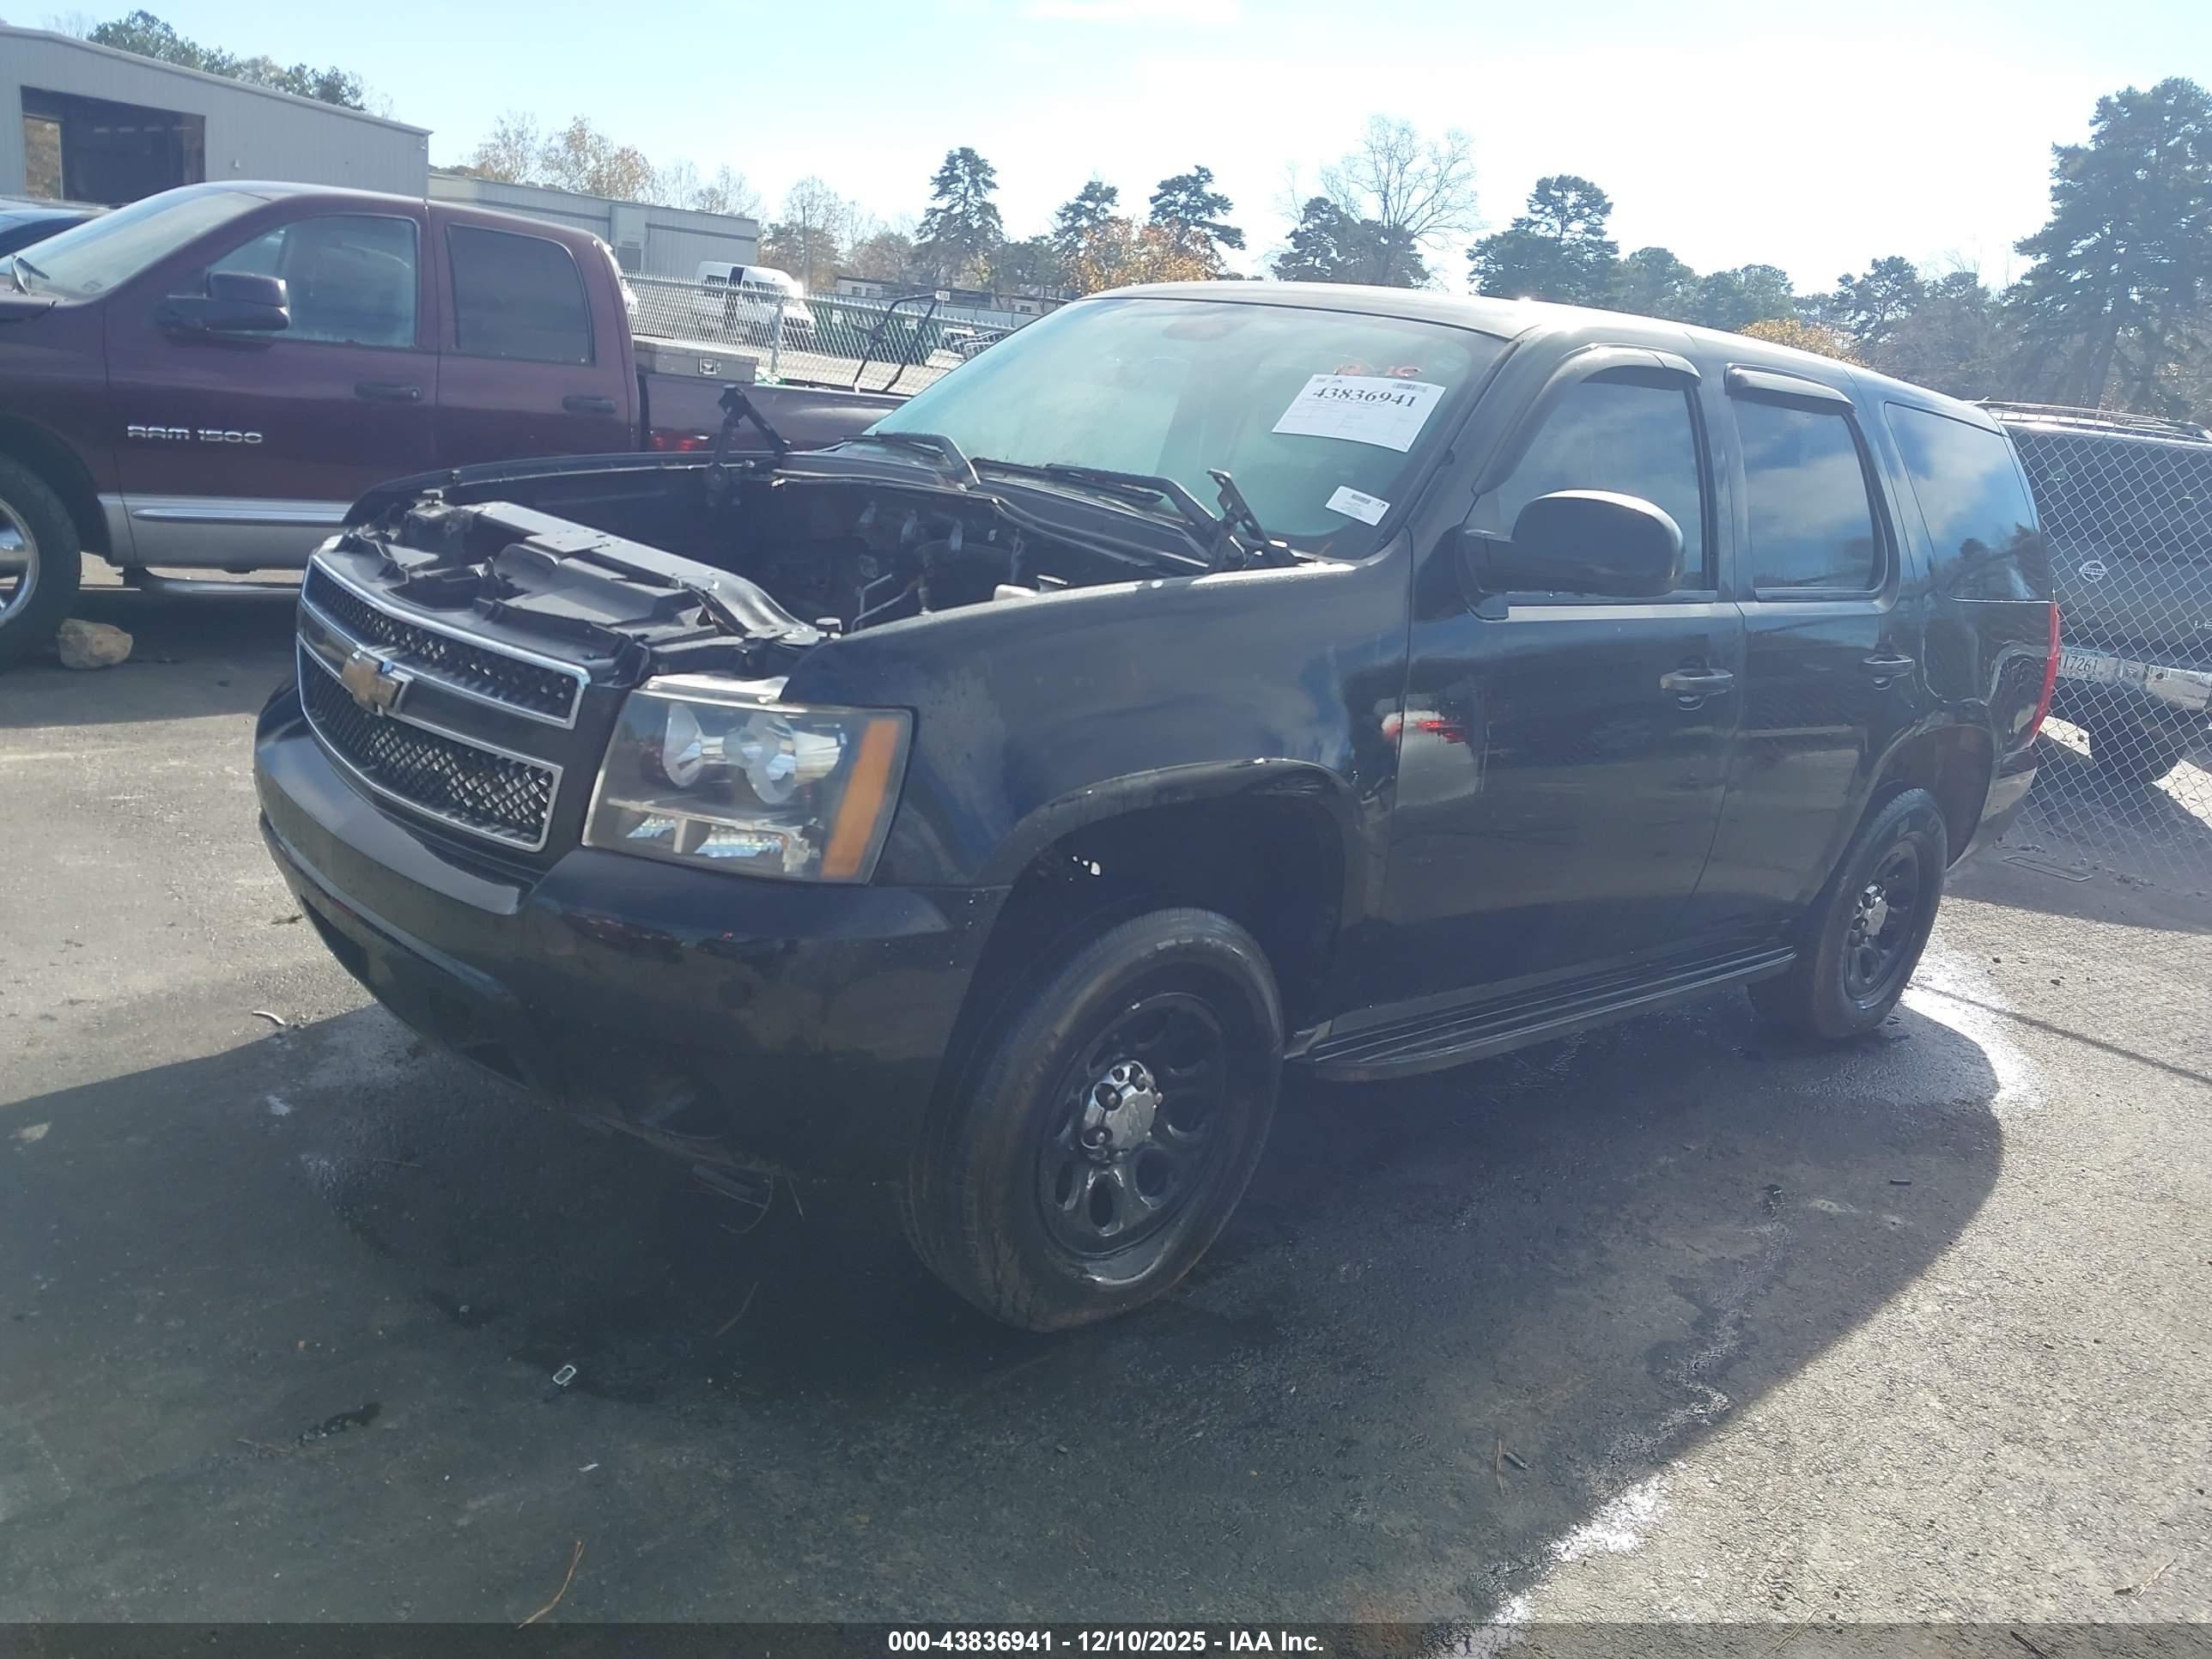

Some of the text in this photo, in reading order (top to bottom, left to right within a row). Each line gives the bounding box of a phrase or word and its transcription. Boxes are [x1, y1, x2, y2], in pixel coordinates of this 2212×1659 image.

[1312, 386, 1418, 408] 43836941
[127, 425, 263, 444] RAM 1500
